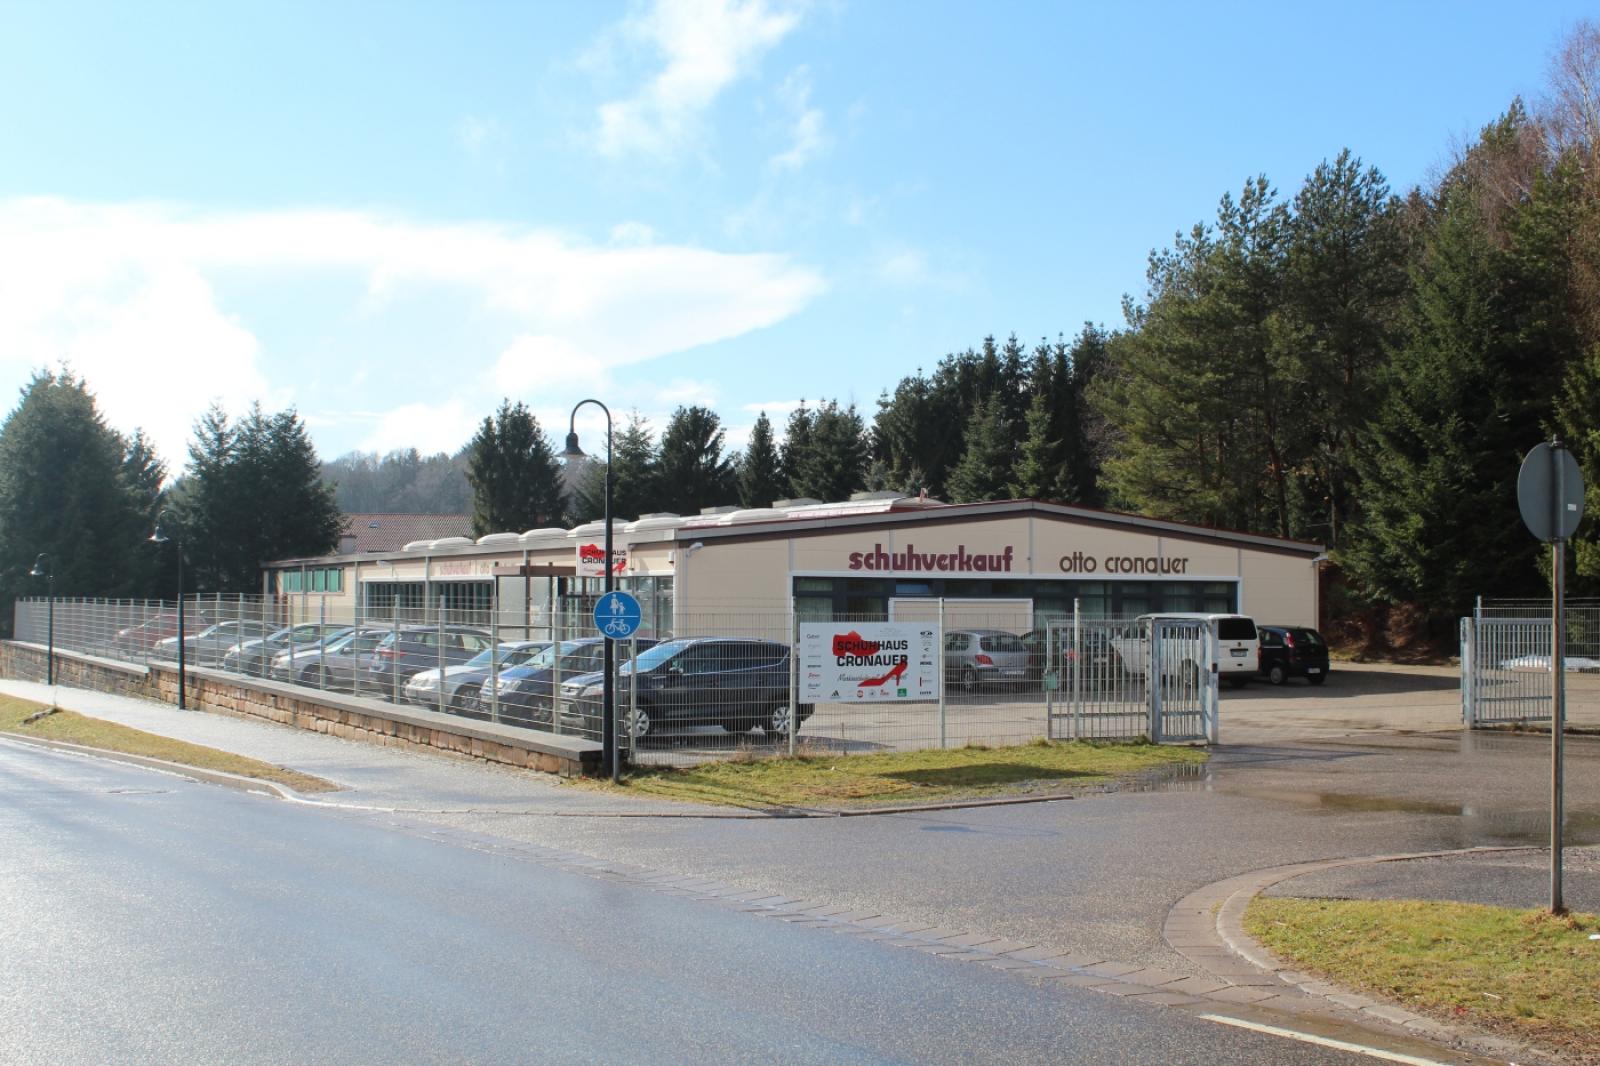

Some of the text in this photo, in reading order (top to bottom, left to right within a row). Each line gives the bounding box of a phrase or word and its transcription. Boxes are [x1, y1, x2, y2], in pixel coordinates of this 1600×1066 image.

[849, 543, 1013, 572] schuhverkauf
[1059, 551, 1189, 574] otto cronauer
[837, 640, 908, 651] SCHUHHAUS
[836, 654, 908, 667] CRONAUER
